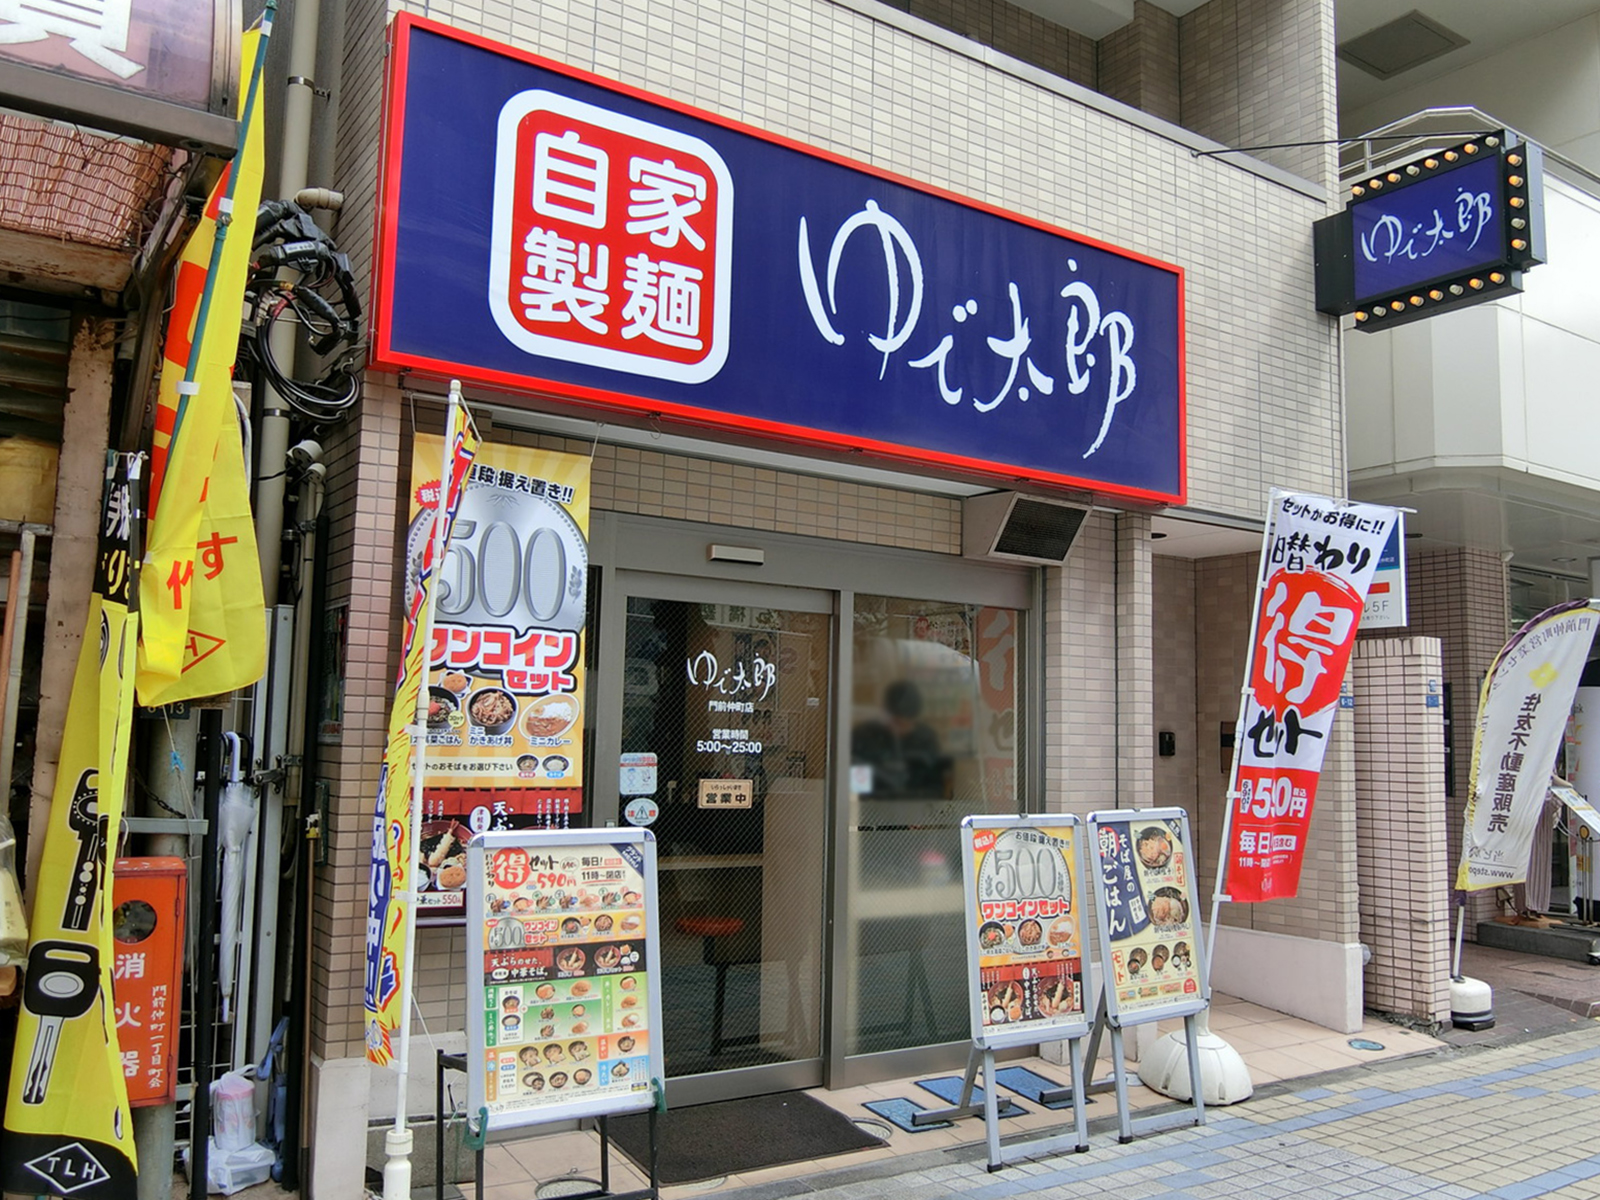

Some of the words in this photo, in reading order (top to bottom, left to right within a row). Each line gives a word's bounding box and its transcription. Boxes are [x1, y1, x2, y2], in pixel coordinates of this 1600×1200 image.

[532, 130, 707, 252] 自家
[1361, 187, 1493, 264] ゆで太郎
[520, 226, 704, 351] 製麺
[798, 199, 1137, 459] ゆで太郎
[1282, 497, 1386, 535] セットがお得に!!
[436, 519, 567, 621] 500
[1262, 582, 1354, 704] 得
[506, 671, 571, 691] セット
[686, 649, 776, 702] ゆで太郎
[708, 700, 755, 713] 門前仲町店
[469, 736, 512, 745] かきあげ丼
[530, 737, 572, 746] ミニカレー
[712, 729, 749, 740] 営業時間
[1248, 708, 1323, 758] セット
[412, 763, 514, 771] セトのおそばをお選び下さい
[705, 792, 747, 804] 営業中
[1252, 776, 1308, 818] 50円
[496, 853, 526, 884] 得
[529, 855, 559, 872] セット
[994, 848, 1057, 898] 500
[1099, 827, 1126, 935] 朝ごはん
[1119, 834, 1135, 892] そば屋の
[524, 919, 558, 932] ワンコイン
[983, 899, 1070, 919] ワンコインセット
[525, 932, 547, 944] セット
[1113, 954, 1124, 982] セット
[115, 951, 147, 1078] 消火器
[147, 985, 169, 1089] 門前仲町一丁目町会
[47, 1156, 98, 1179] TLH
